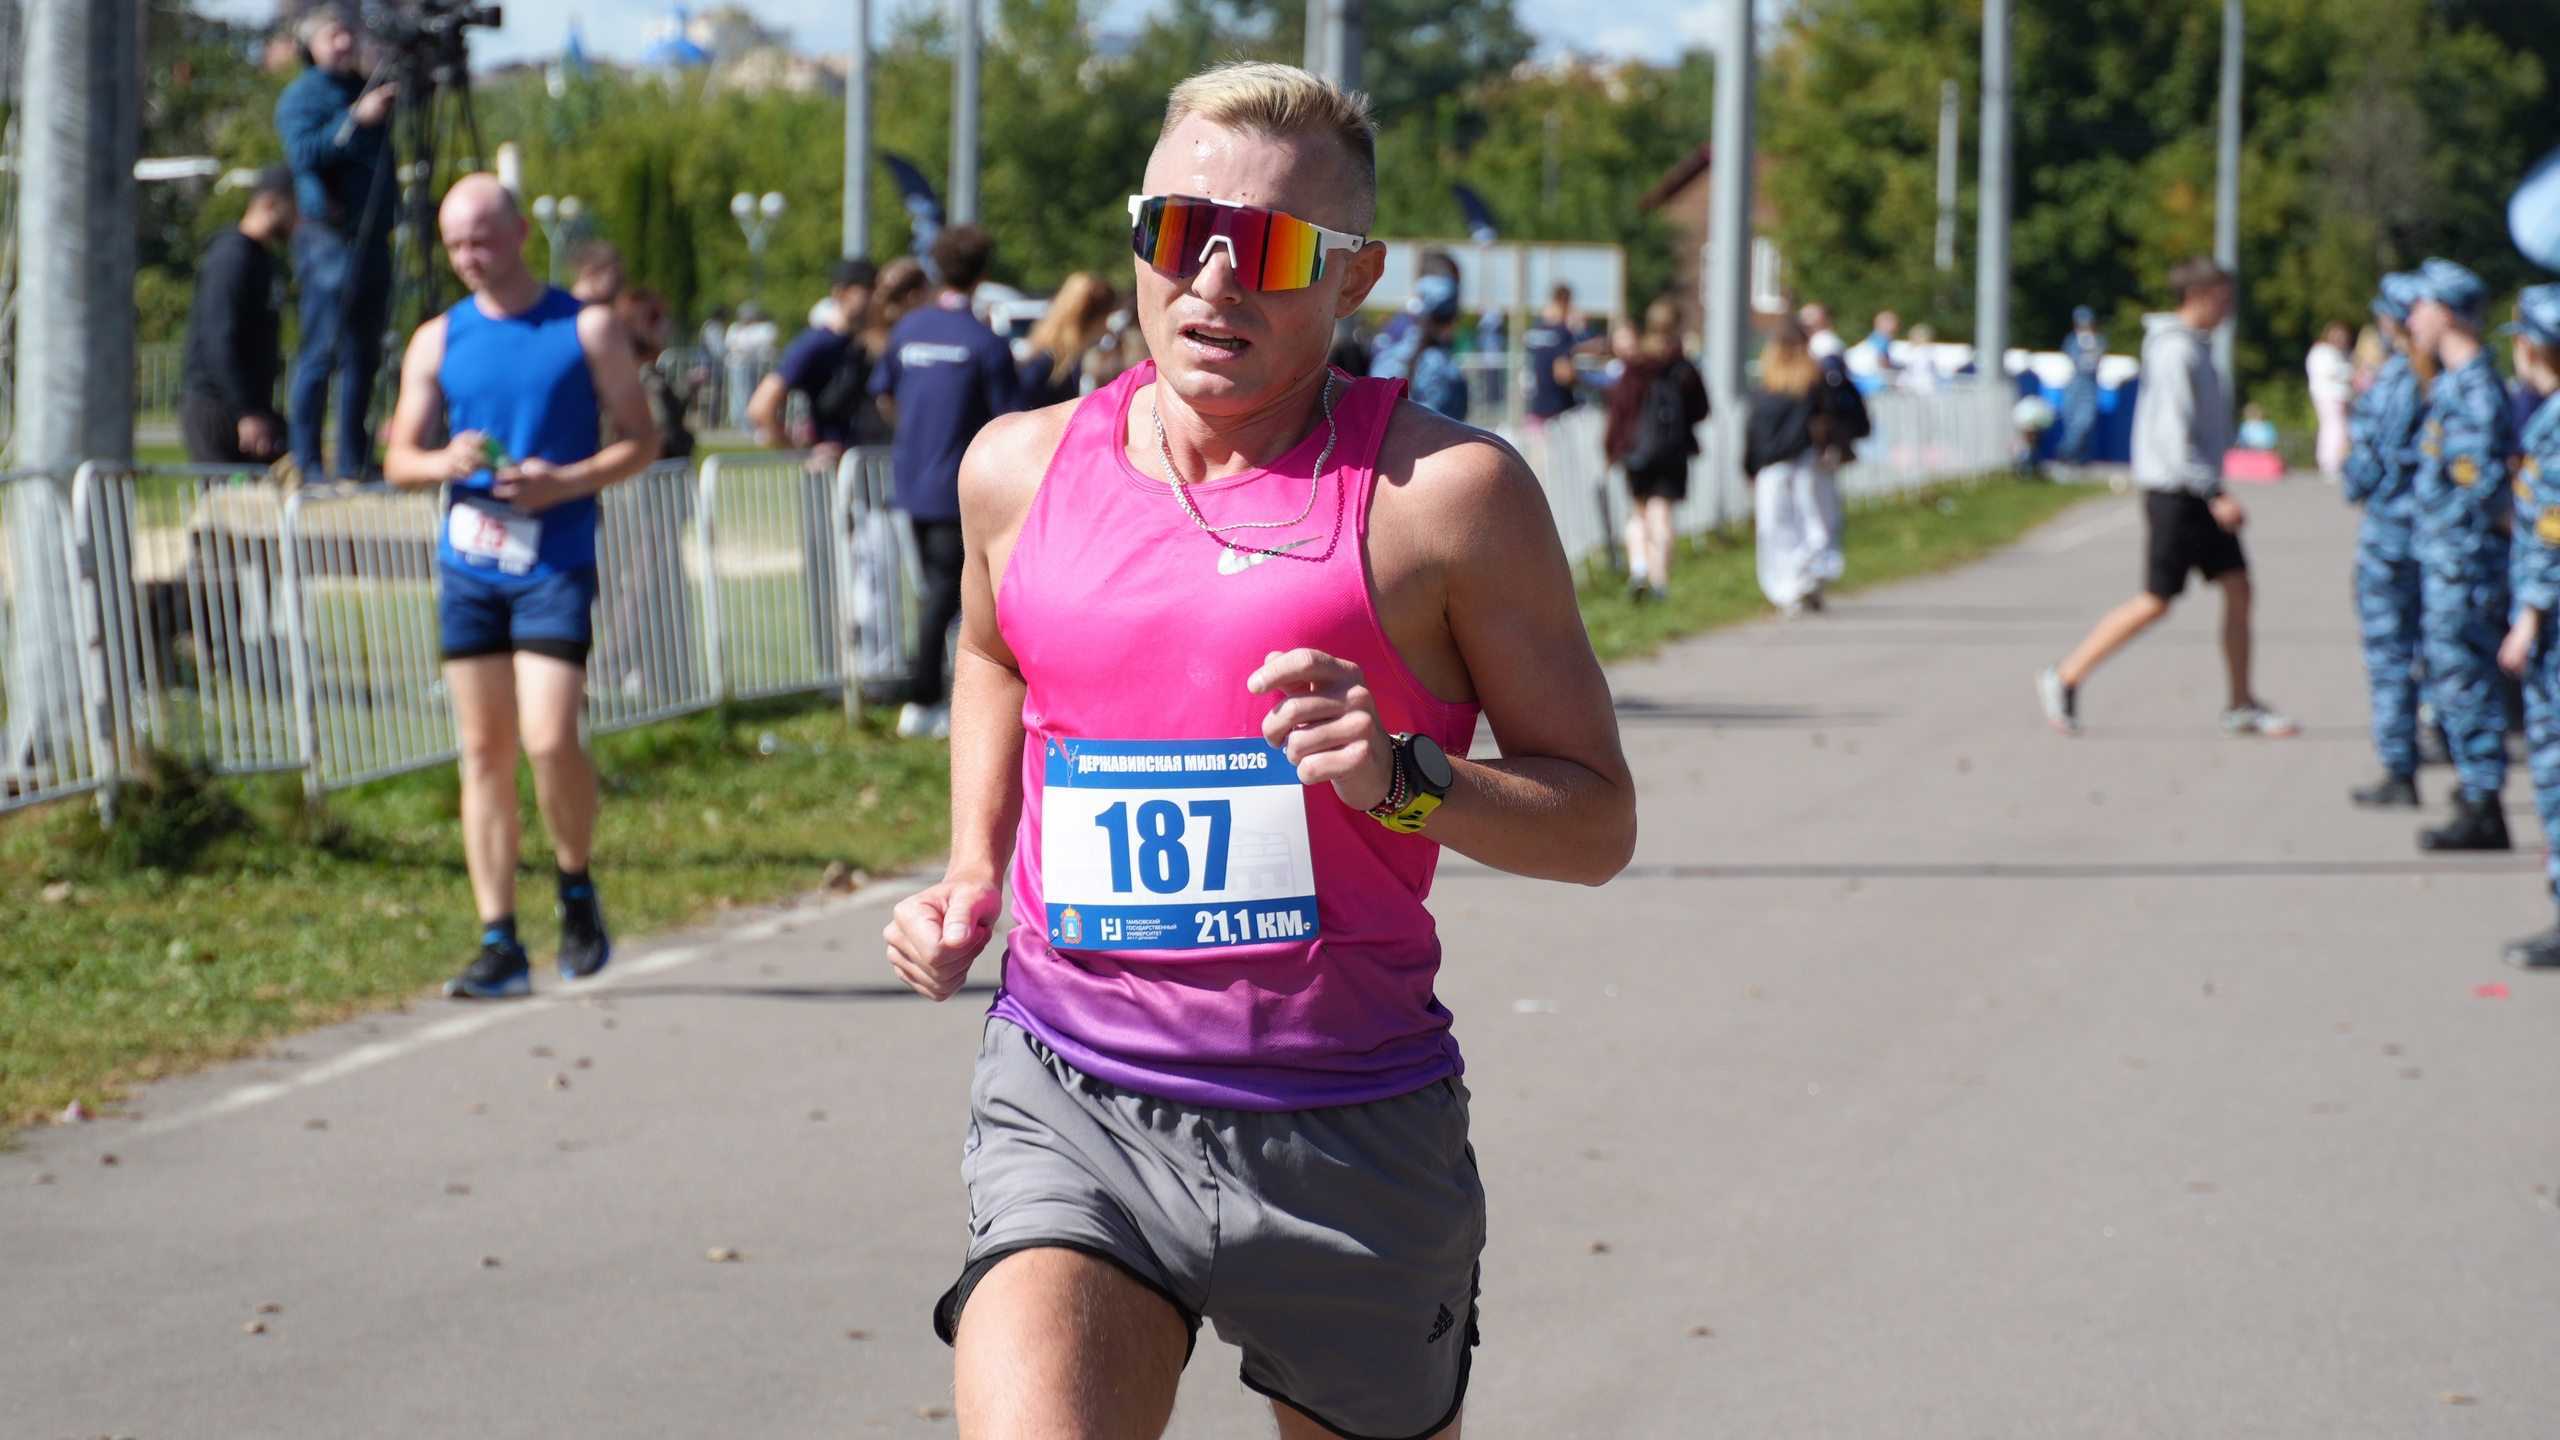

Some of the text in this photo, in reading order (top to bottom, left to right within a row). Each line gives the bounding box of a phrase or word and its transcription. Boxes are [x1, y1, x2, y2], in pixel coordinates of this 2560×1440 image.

[1078, 752, 1267, 773] ДЕРЖАВИНСКАЯ МИЛЯ 2026
[1095, 799, 1231, 894] 187
[1195, 909, 1303, 944] 21,1 КМ
